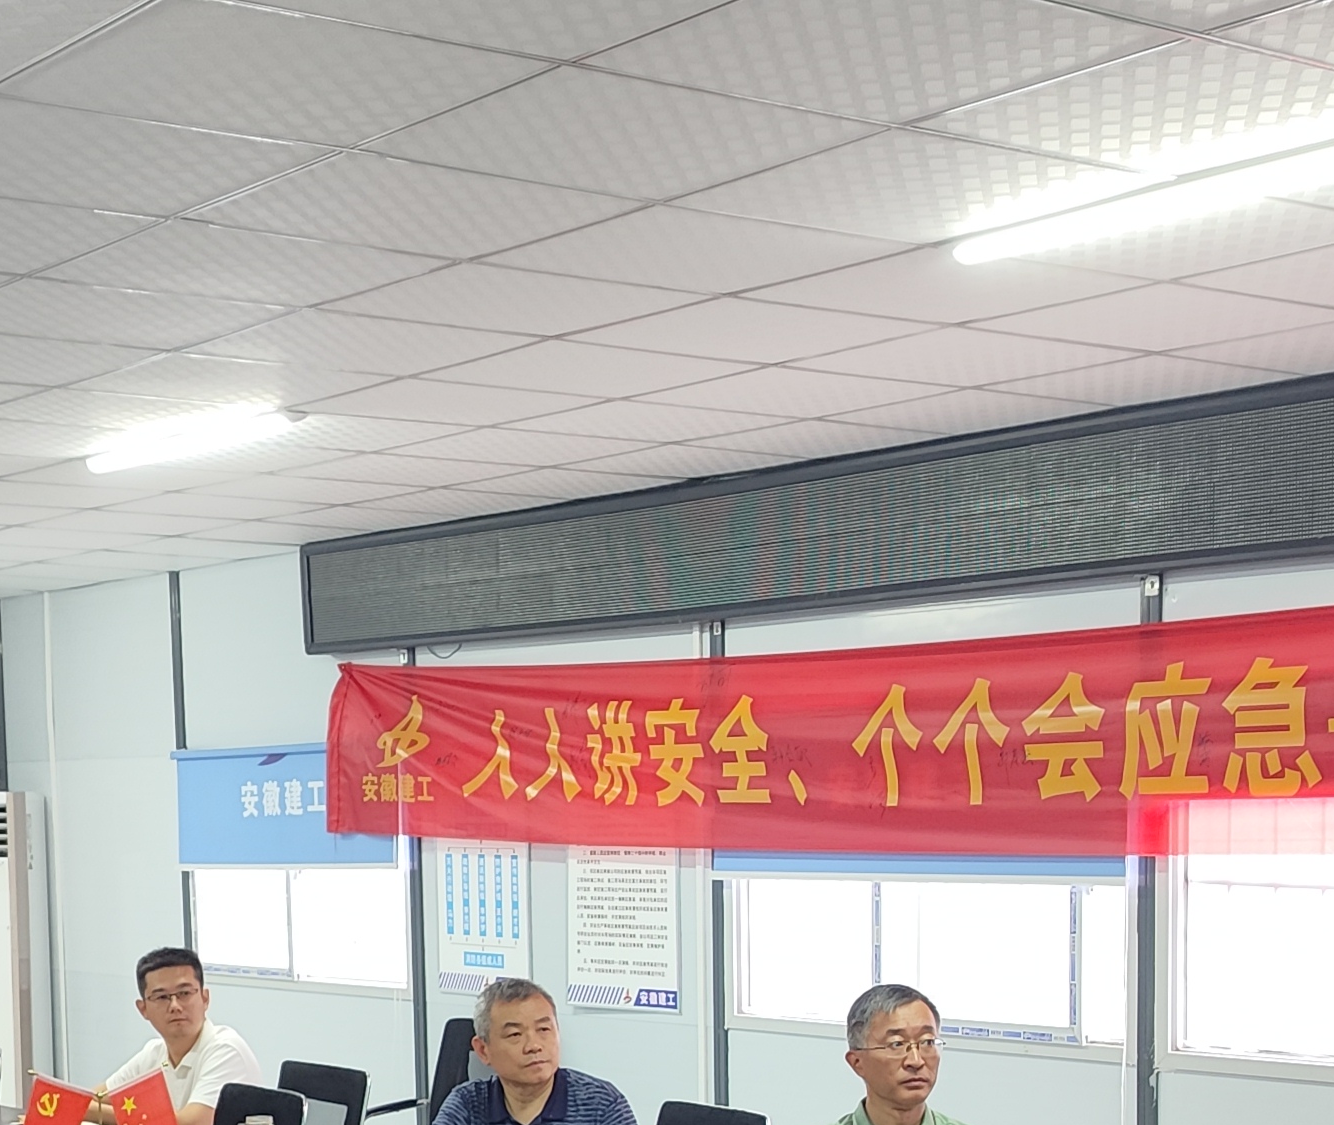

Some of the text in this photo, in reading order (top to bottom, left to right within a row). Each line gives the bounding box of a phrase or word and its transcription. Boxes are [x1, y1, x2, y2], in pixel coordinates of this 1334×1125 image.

[240, 778, 326, 818] 安徽建工
[362, 773, 435, 803] 安徽建工
